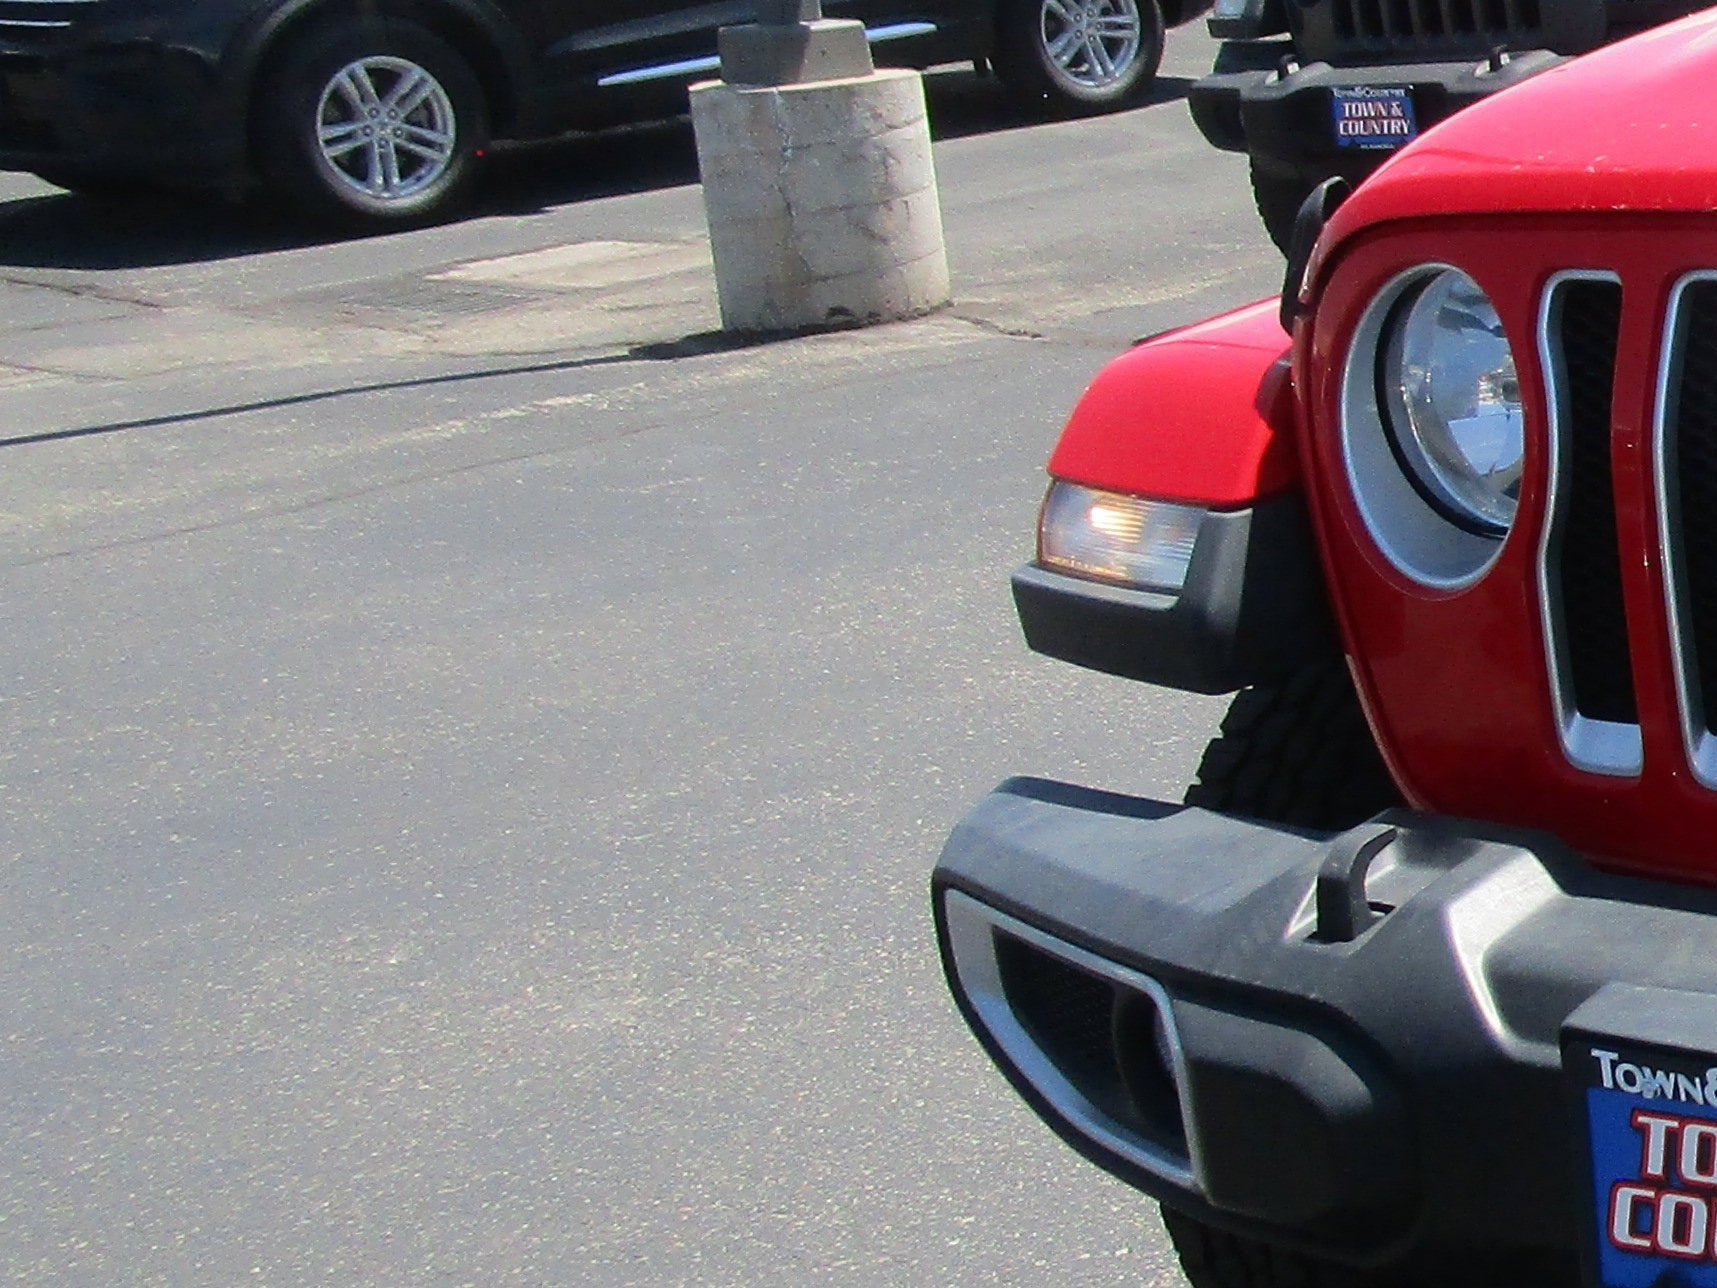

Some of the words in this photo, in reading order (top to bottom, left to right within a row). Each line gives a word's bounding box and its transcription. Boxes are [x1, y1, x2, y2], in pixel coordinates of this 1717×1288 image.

[1343, 101, 1388, 118] TOWN
[1391, 101, 1404, 117] &
[1339, 119, 1410, 136] COUNTRY
